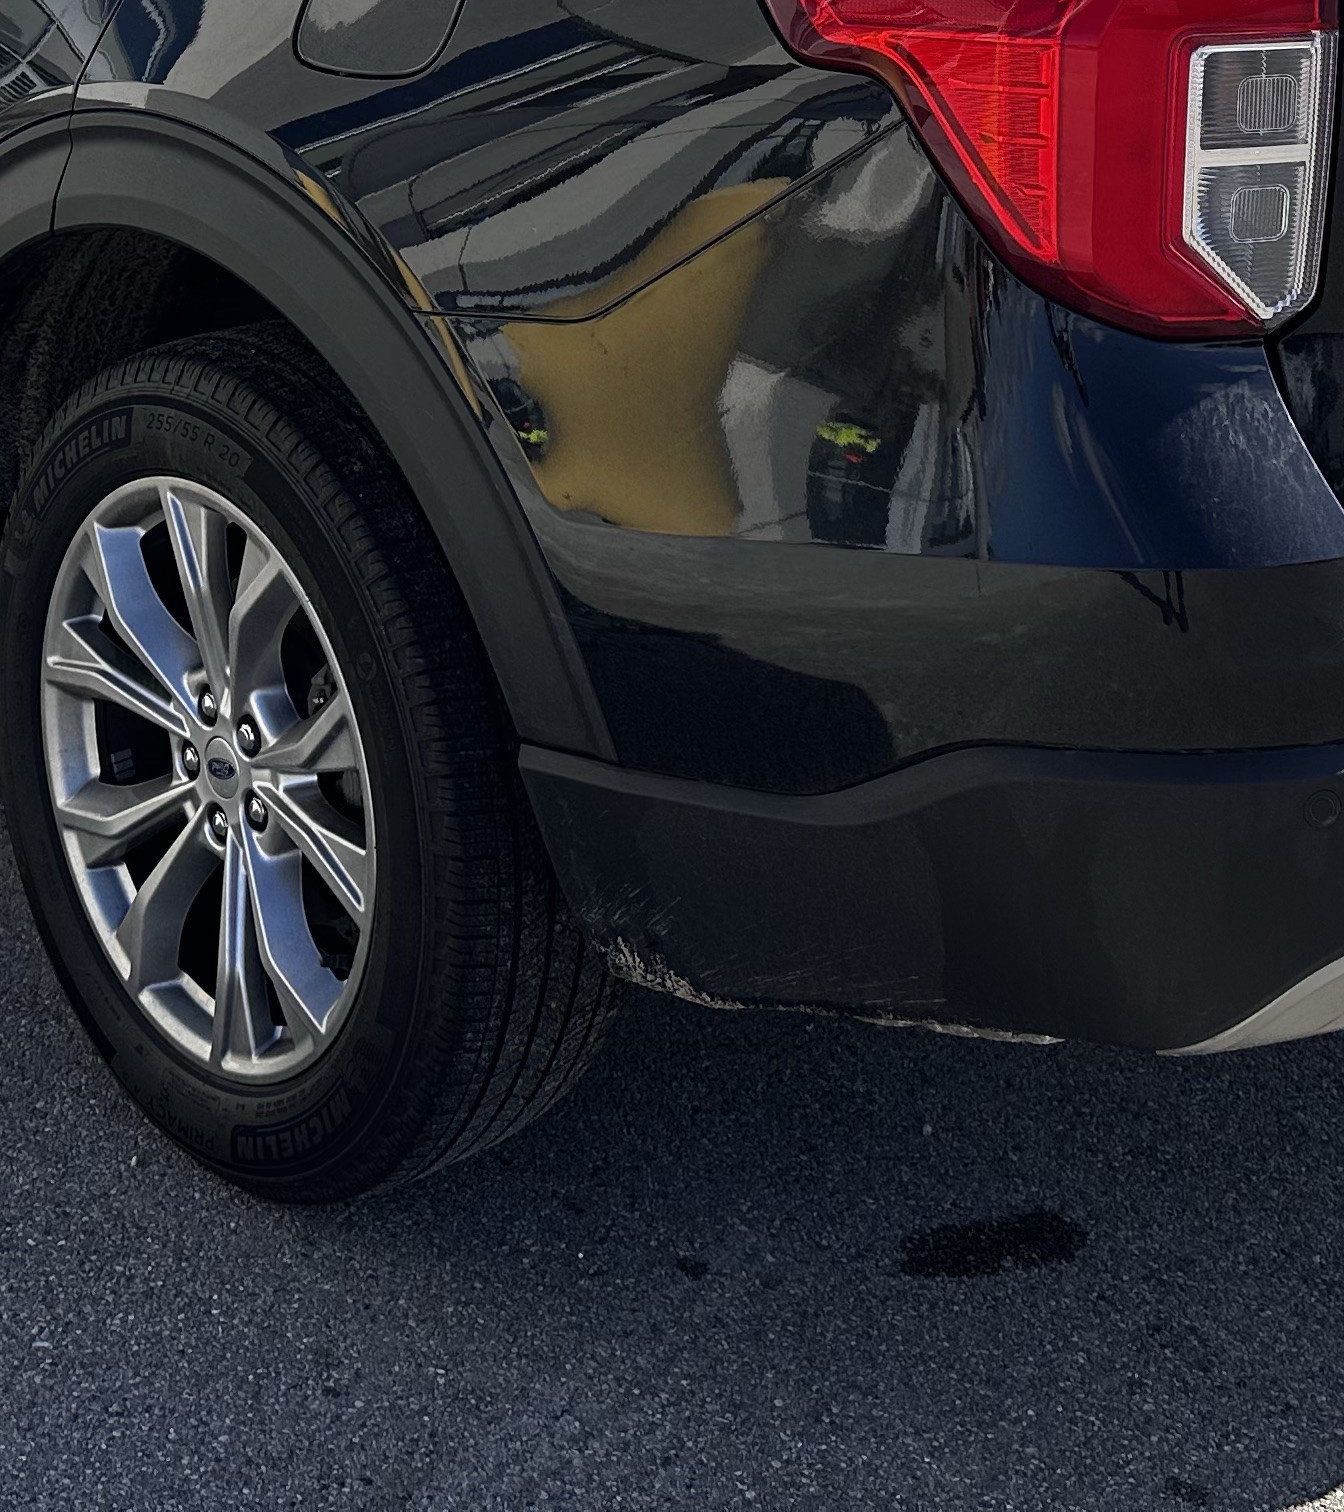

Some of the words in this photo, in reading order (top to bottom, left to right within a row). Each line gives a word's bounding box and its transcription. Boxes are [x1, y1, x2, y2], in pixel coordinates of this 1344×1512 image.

[33, 414, 128, 512] MICHELIN
[145, 412, 200, 441] 255/55
[202, 433, 216, 452] R
[218, 443, 240, 468] 20
[145, 1097, 215, 1150] PRIMACY
[236, 1087, 353, 1162] MICHELIN
